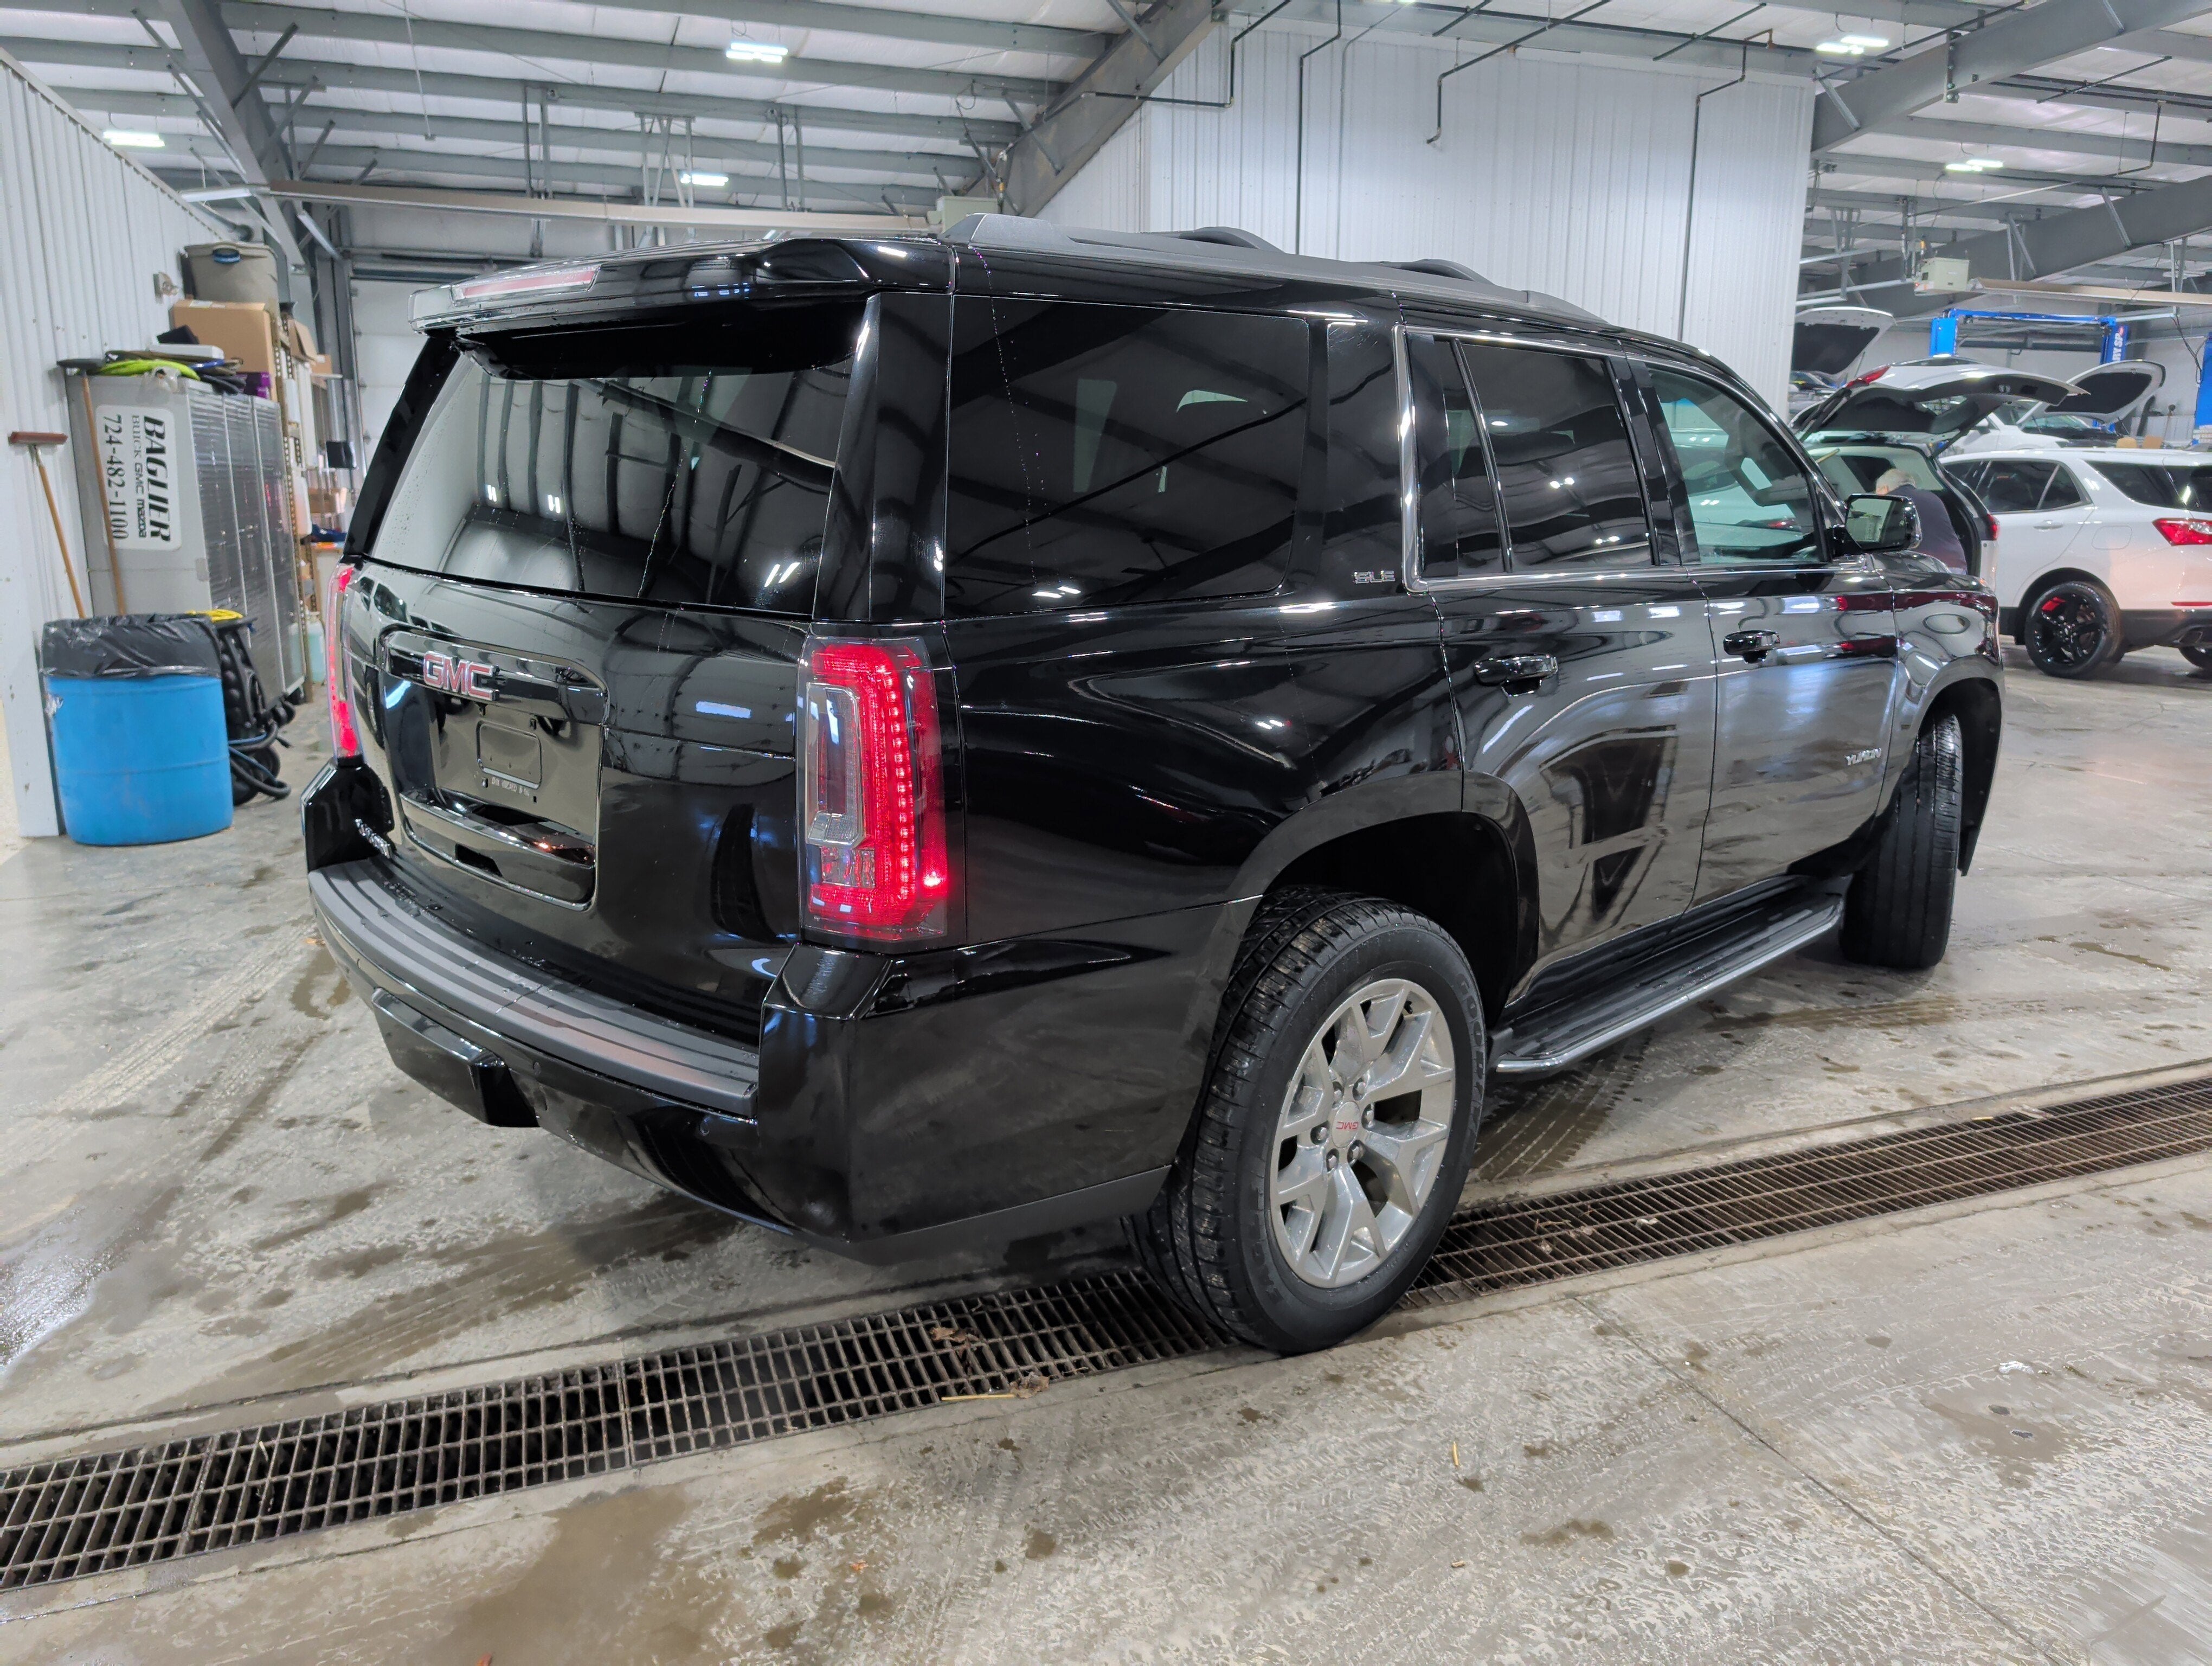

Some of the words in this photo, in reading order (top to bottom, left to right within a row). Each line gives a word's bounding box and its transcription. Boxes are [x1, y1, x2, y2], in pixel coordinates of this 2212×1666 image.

[132, 415, 142, 458] BUICK
[103, 414, 129, 540] 724-482-1100
[134, 463, 145, 495] GMC
[144, 415, 171, 542] BAGLIER
[137, 499, 147, 538] mazda
[1354, 570, 1395, 584] SLE
[423, 650, 496, 701] GMC
[1335, 1121, 1359, 1130] GMC
